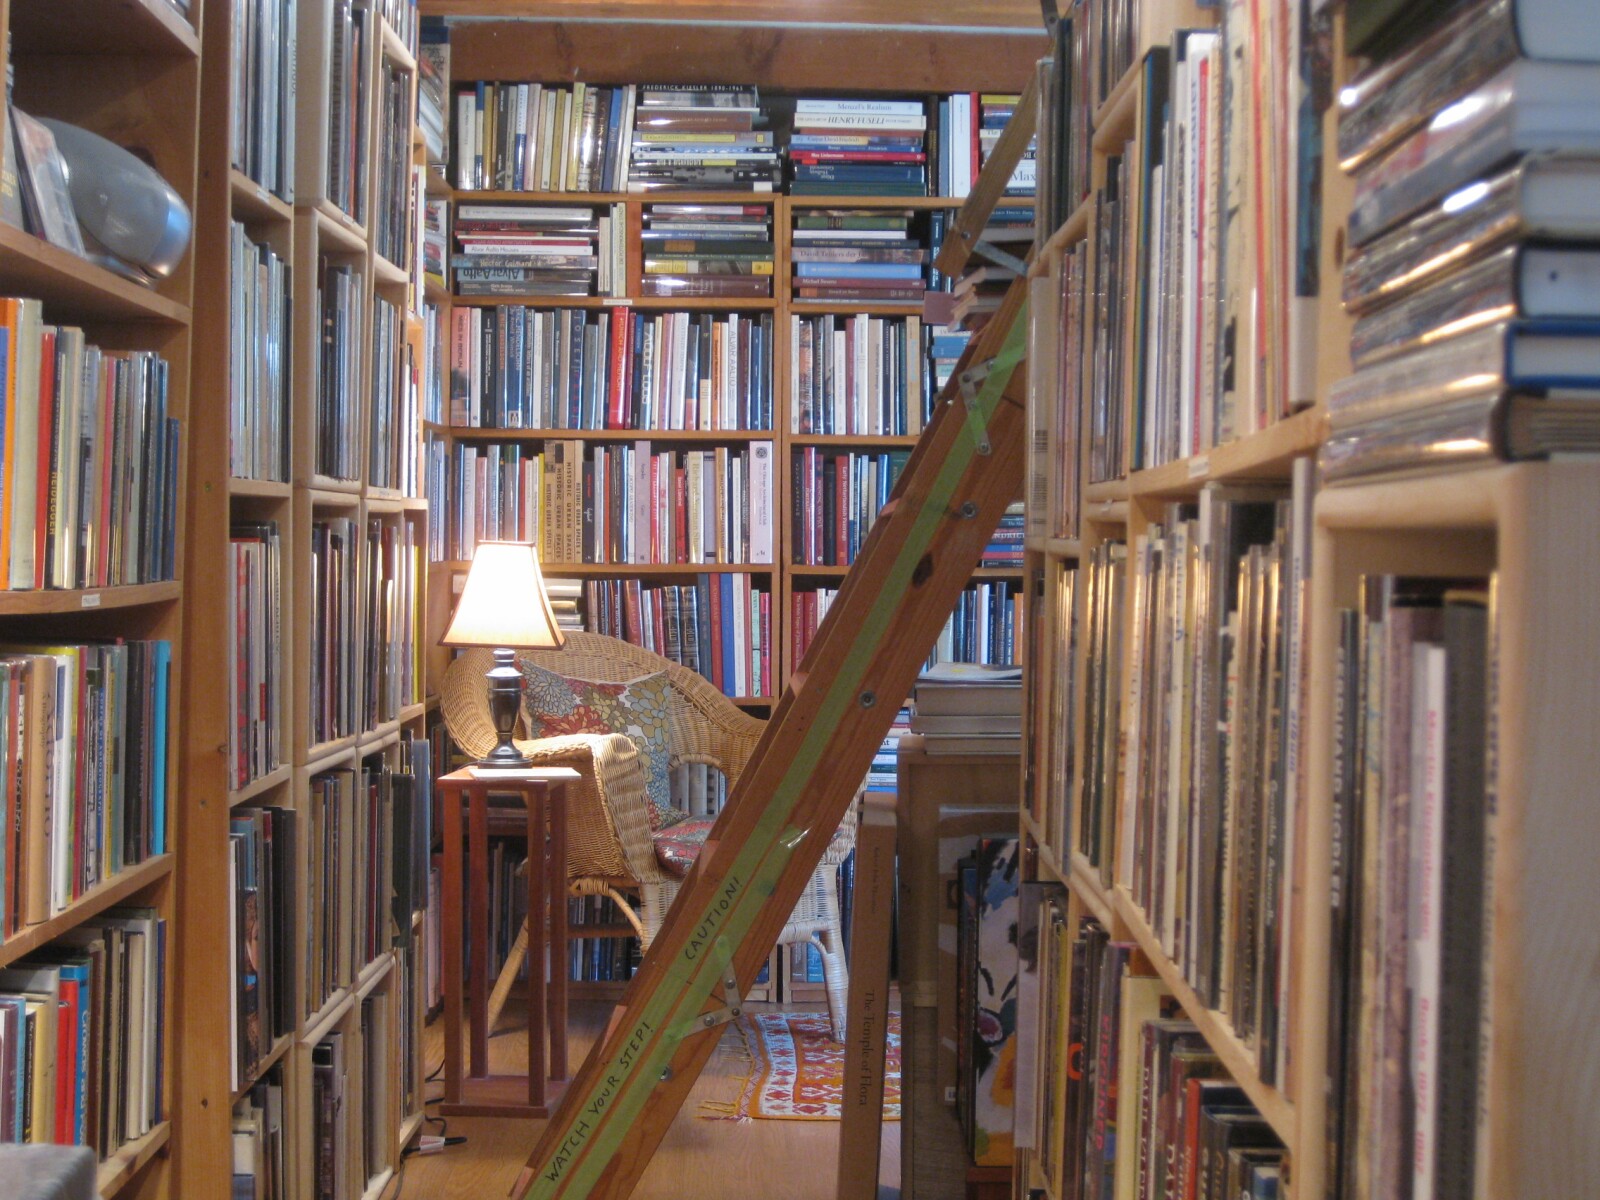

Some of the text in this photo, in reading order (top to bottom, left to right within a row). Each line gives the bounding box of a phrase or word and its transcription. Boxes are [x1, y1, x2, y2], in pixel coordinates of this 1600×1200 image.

[827, 113, 855, 124] HENRY
[856, 114, 886, 125] FUSELI
[866, 103, 892, 111] Realism
[1010, 171, 1036, 182] Max
[462, 269, 520, 281] Alvar Aalto
[456, 314, 464, 332] MIES
[456, 342, 464, 369] BERLIN
[642, 332, 652, 404] ADOLF LOOS
[729, 330, 737, 387] ALVAR AALTO
[49, 471, 58, 535] HEIDEGGER
[692, 463, 701, 496] Richard
[1330, 647, 1345, 908] FERDINAND HODLER
[685, 876, 743, 960] CAUTION!
[859, 989, 875, 1106] The Temple of Flora
[545, 1021, 655, 1183] WATCH YOUR STEP!
[1138, 1066, 1150, 1200] PAUL KLEE
